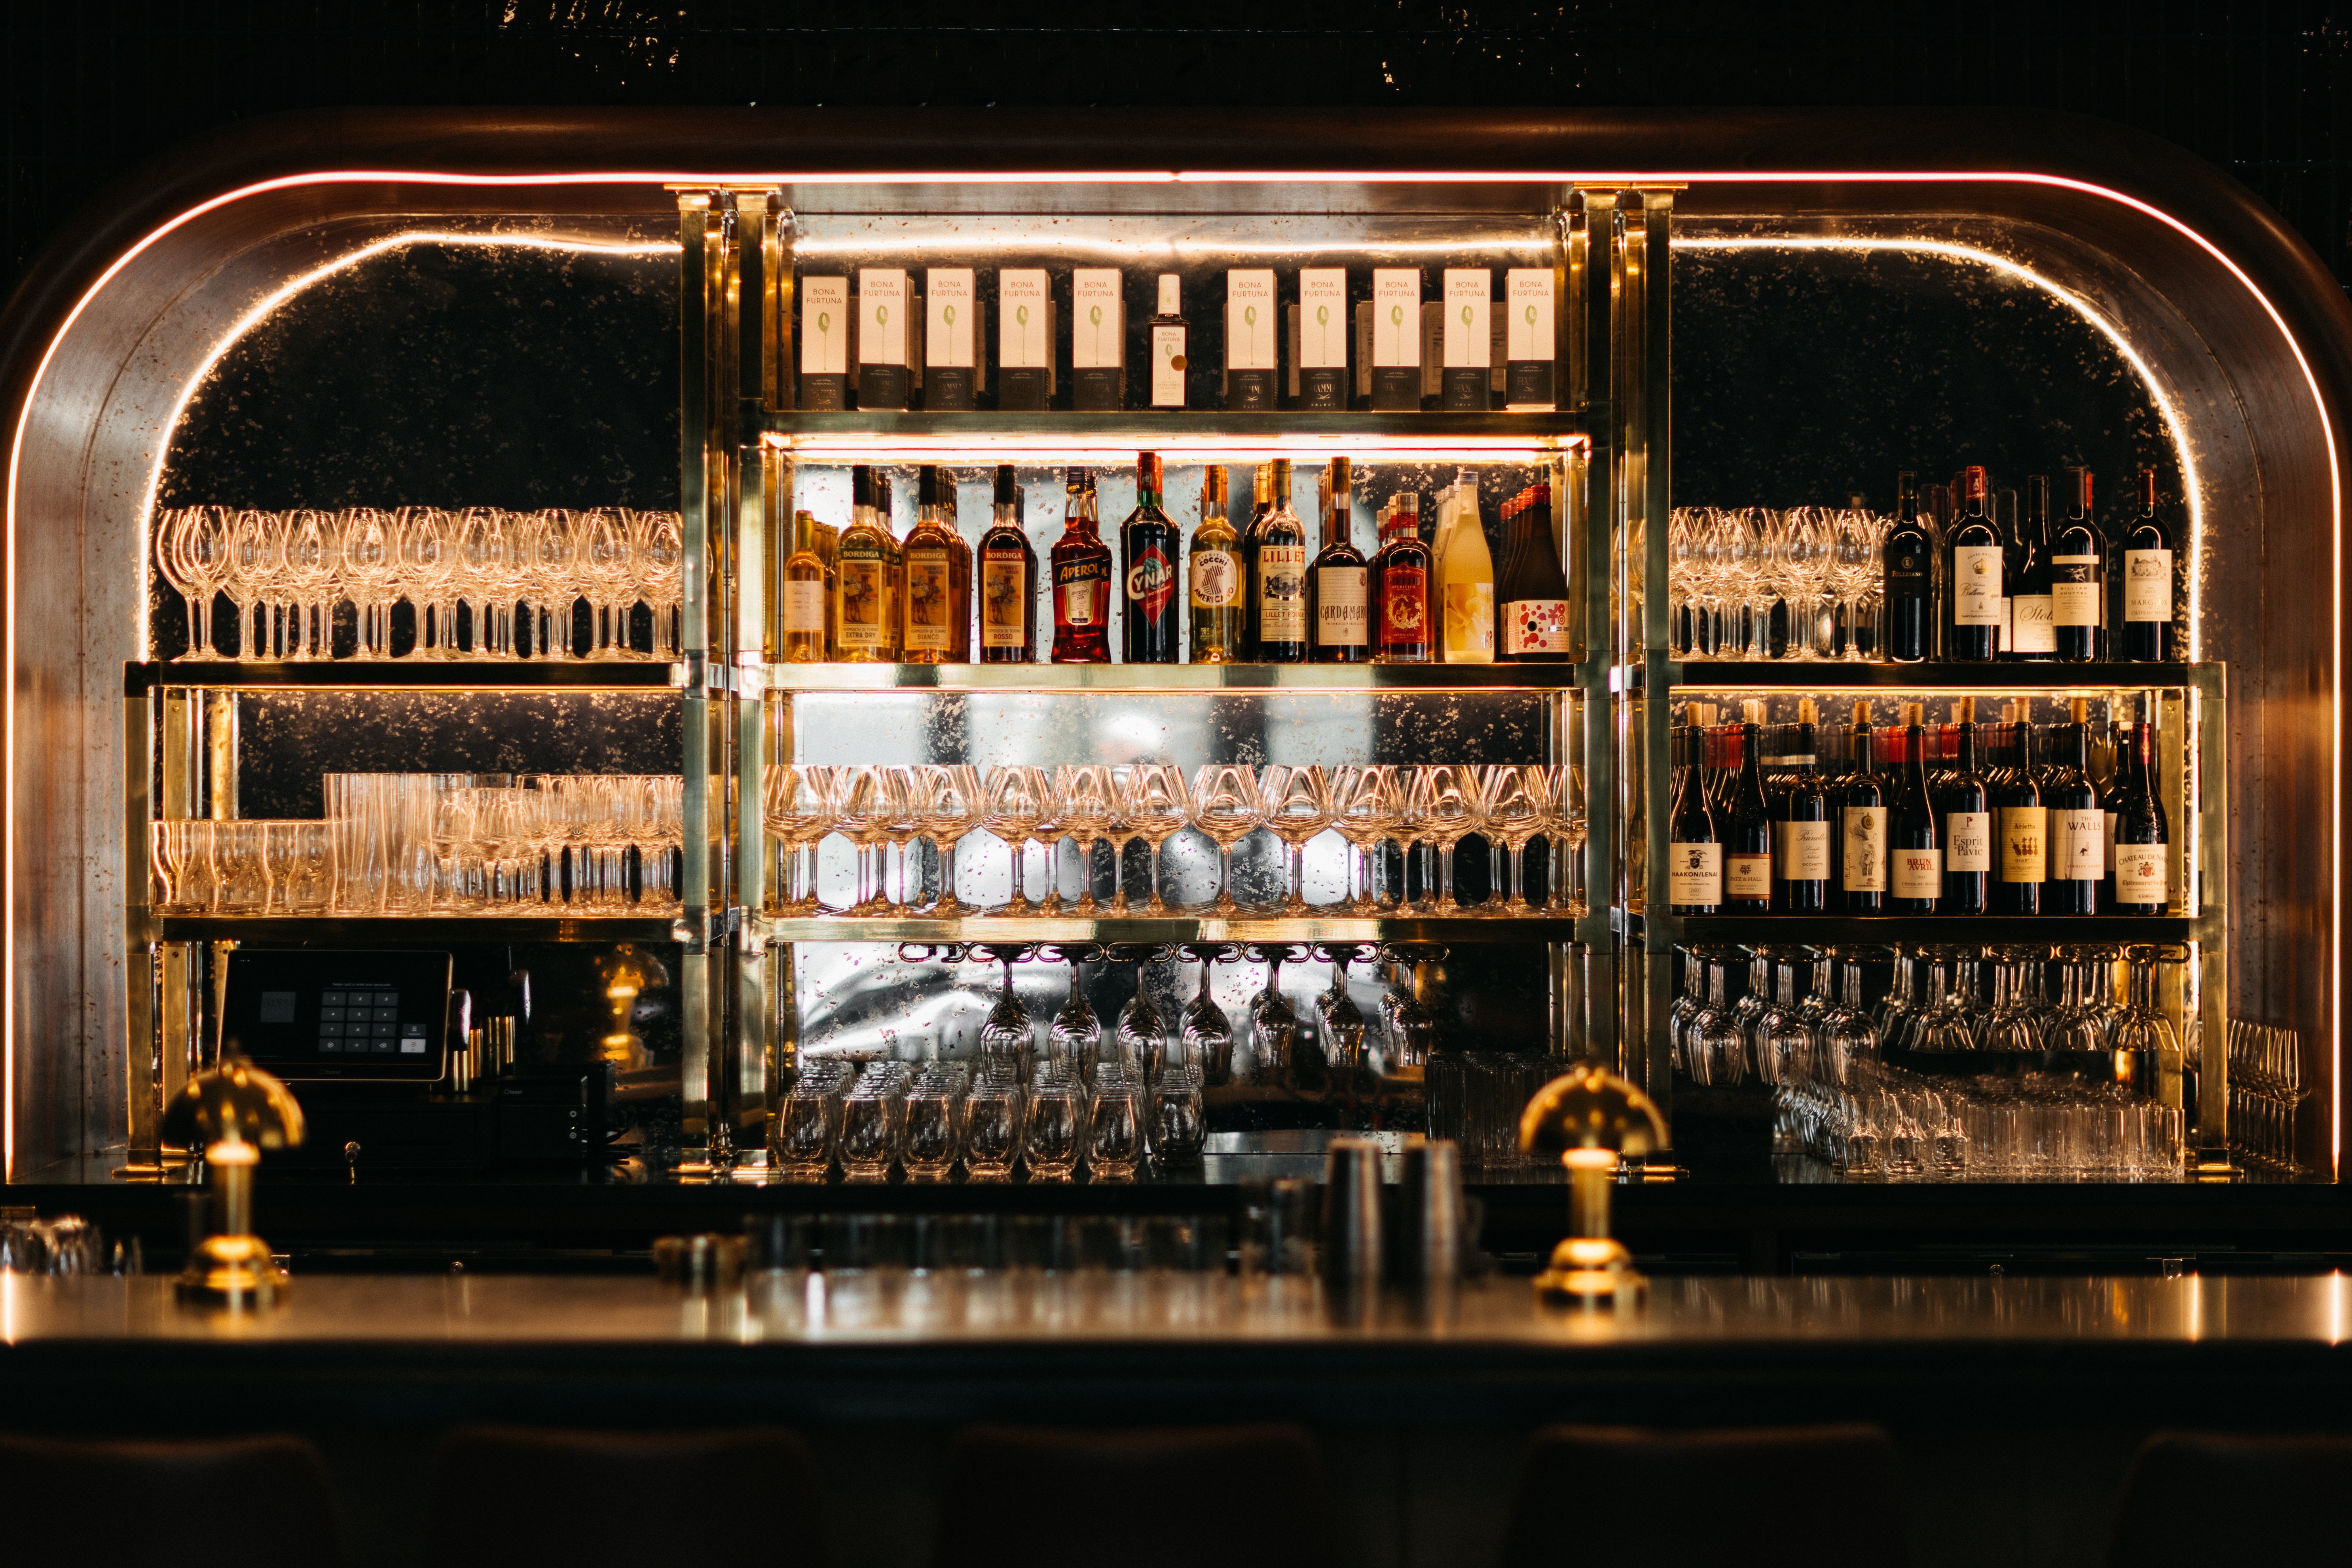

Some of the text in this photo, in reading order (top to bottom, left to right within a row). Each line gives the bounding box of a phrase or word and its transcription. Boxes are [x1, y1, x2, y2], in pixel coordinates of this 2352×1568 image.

[1198, 553, 1230, 563] APERITIVO
[1199, 557, 1227, 566] COCCHI
[1263, 550, 1305, 563] LILLET
[1060, 563, 1099, 582] APEROL
[1127, 565, 1172, 600] CYNAR
[1320, 605, 1367, 621] CARDAMARO
[2068, 822, 2101, 830] WALLS
[1953, 835, 1982, 849] Esprit
[1957, 846, 1982, 856] Pavie
